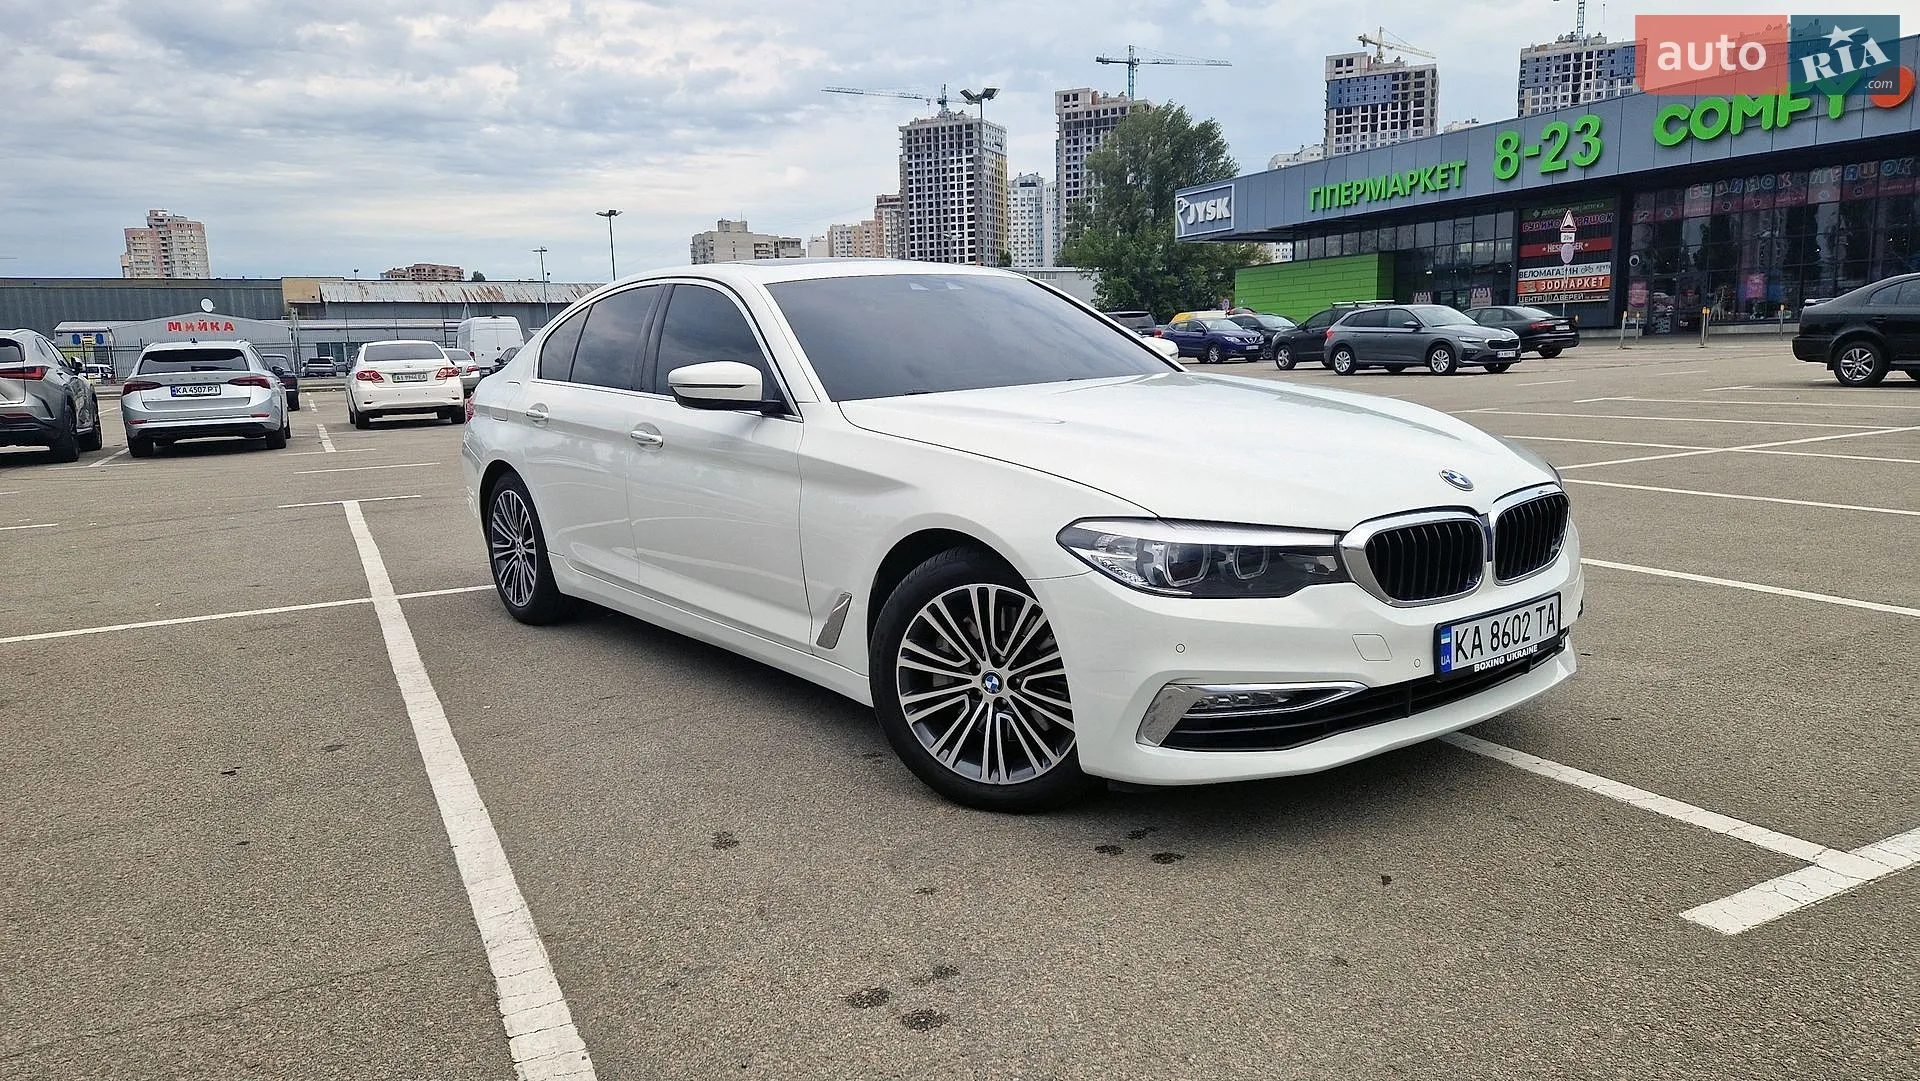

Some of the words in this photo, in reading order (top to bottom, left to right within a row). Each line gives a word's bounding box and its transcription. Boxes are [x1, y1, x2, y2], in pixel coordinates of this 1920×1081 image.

[1653, 72, 1862, 146] COMFY
[1492, 113, 1604, 182] 8-23
[1309, 159, 1467, 211] ГІПЕРМАРКЕТ
[1187, 196, 1231, 225] JYSK
[168, 319, 234, 332] МИЙКА
[176, 386, 188, 394] KA
[1455, 625, 1484, 663] KA
[1490, 611, 1531, 652] 8602
[1536, 602, 1556, 638] TA
[1440, 655, 1451, 666] UA
[1473, 655, 1505, 673] BOXING
[1506, 644, 1538, 661] UKRAINE
